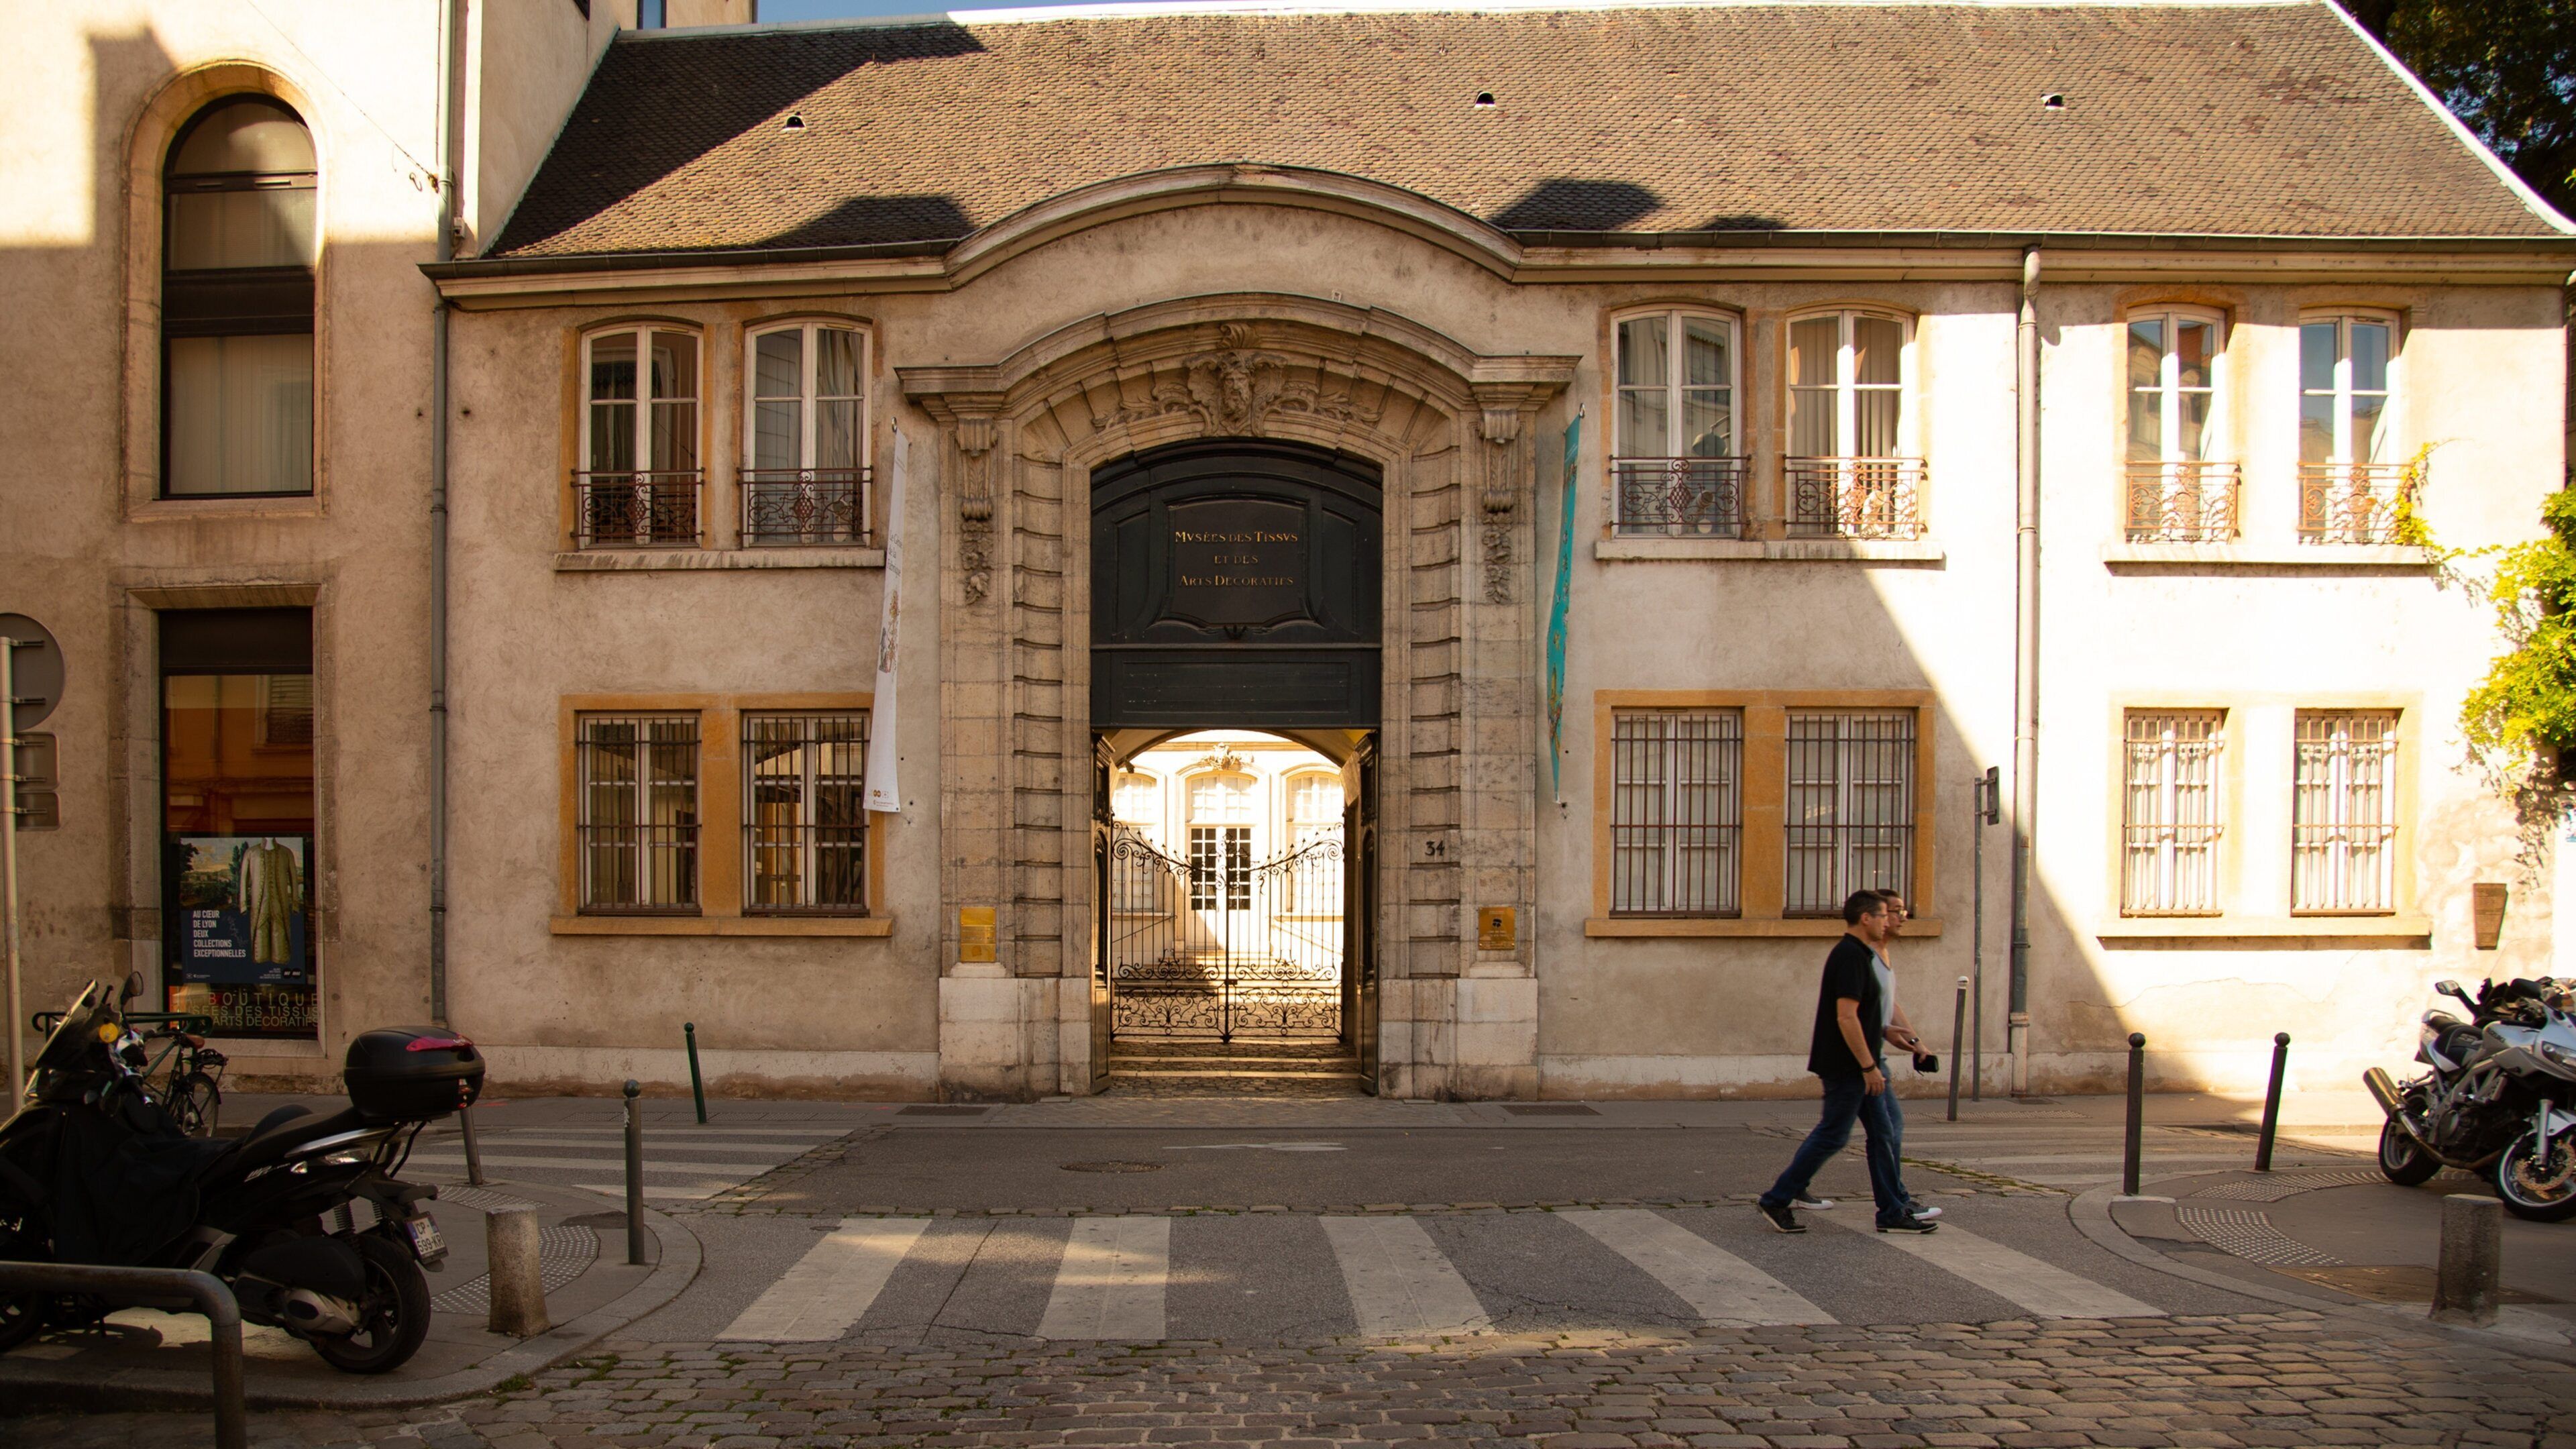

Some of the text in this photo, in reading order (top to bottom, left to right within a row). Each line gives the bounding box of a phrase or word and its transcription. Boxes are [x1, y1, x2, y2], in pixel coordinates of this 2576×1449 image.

[1229, 533, 1252, 543] DES
[1214, 555, 1259, 564] ET DES
[1179, 575, 1212, 586] ARTS
[1425, 840, 1445, 856] 34
[193, 910, 220, 918] AU CŒUR
[193, 920, 217, 928] DE LYON
[193, 930, 209, 938] DEUX
[193, 939, 232, 948] COLLECTIONS
[193, 949, 246, 957] EXCEPTIONNELLES
[208, 992, 317, 1006] BOUTIQUE
[235, 1006, 262, 1016] DES
[268, 1006, 318, 1017] TISSUS
[213, 1016, 243, 1026] ARTS
